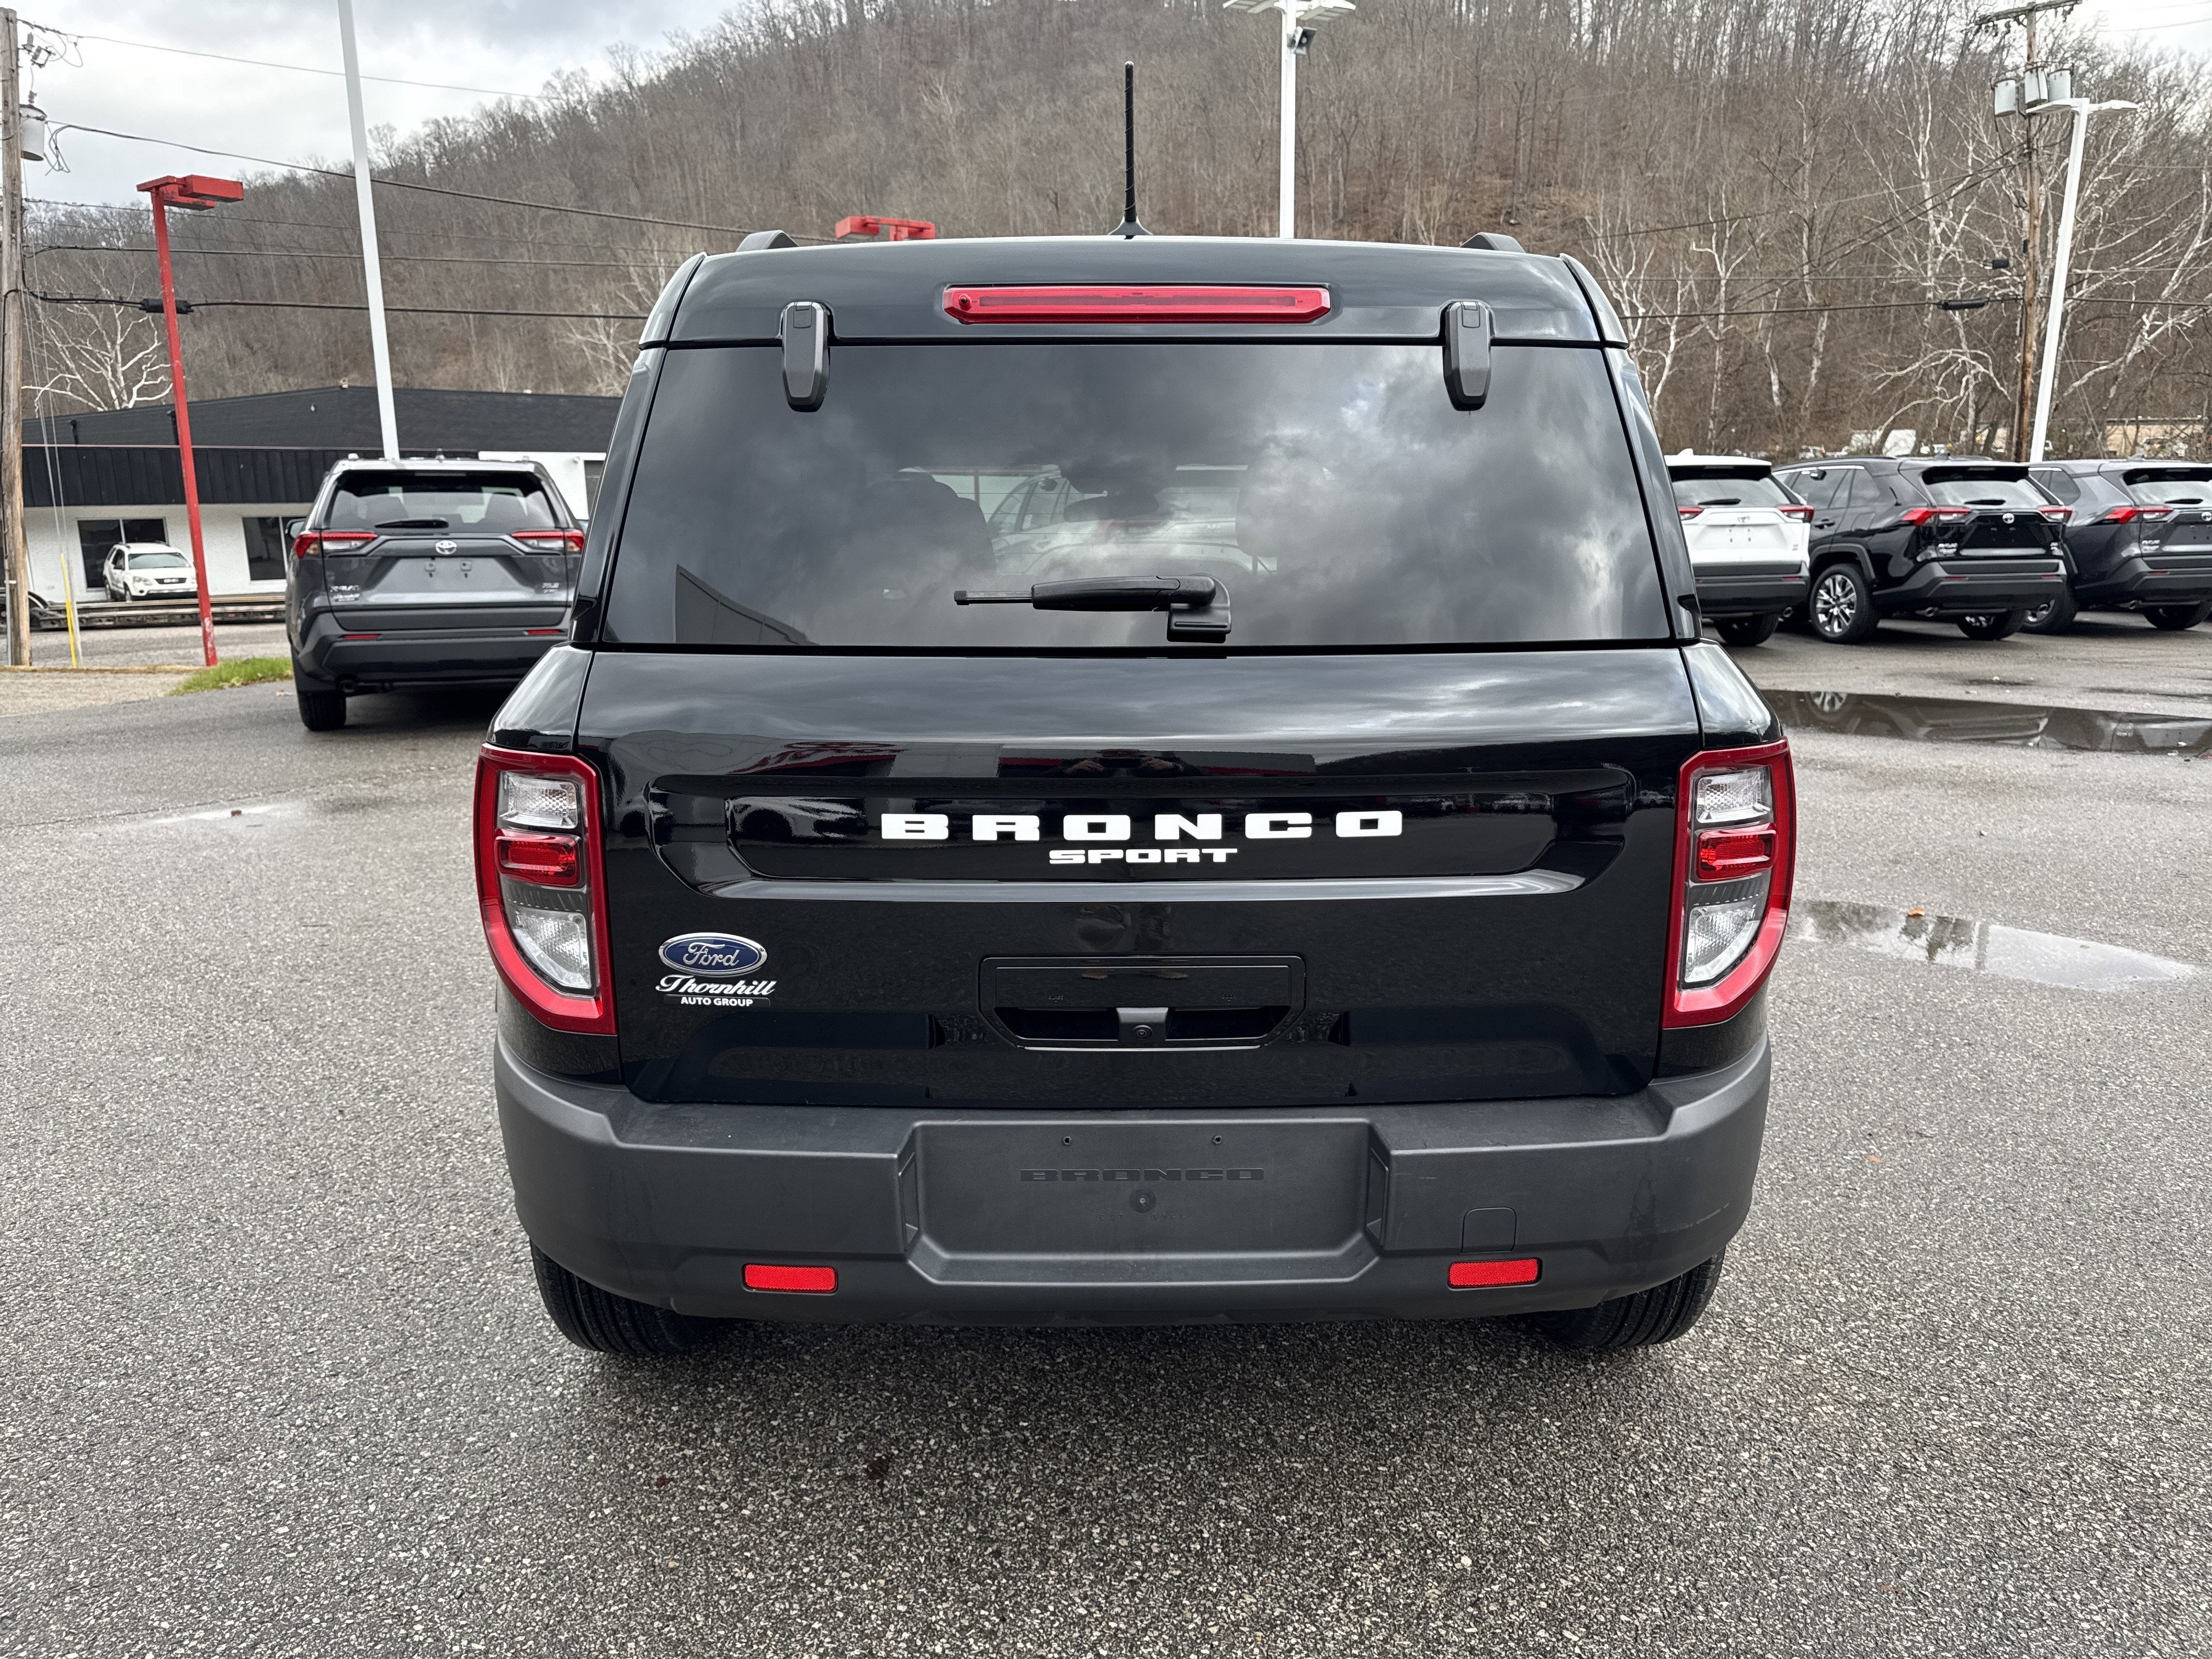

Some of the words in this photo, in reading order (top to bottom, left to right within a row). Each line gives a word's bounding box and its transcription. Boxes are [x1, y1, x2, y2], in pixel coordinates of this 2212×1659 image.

[881, 810, 1402, 841] BRONCO
[1049, 848, 1238, 864] SPORT
[682, 941, 740, 966] Ford
[656, 974, 777, 995] Thornhill
[680, 996, 712, 1005] AUTO
[713, 997, 753, 1007] GROUP
[1020, 1168, 1264, 1182] BRONCO
